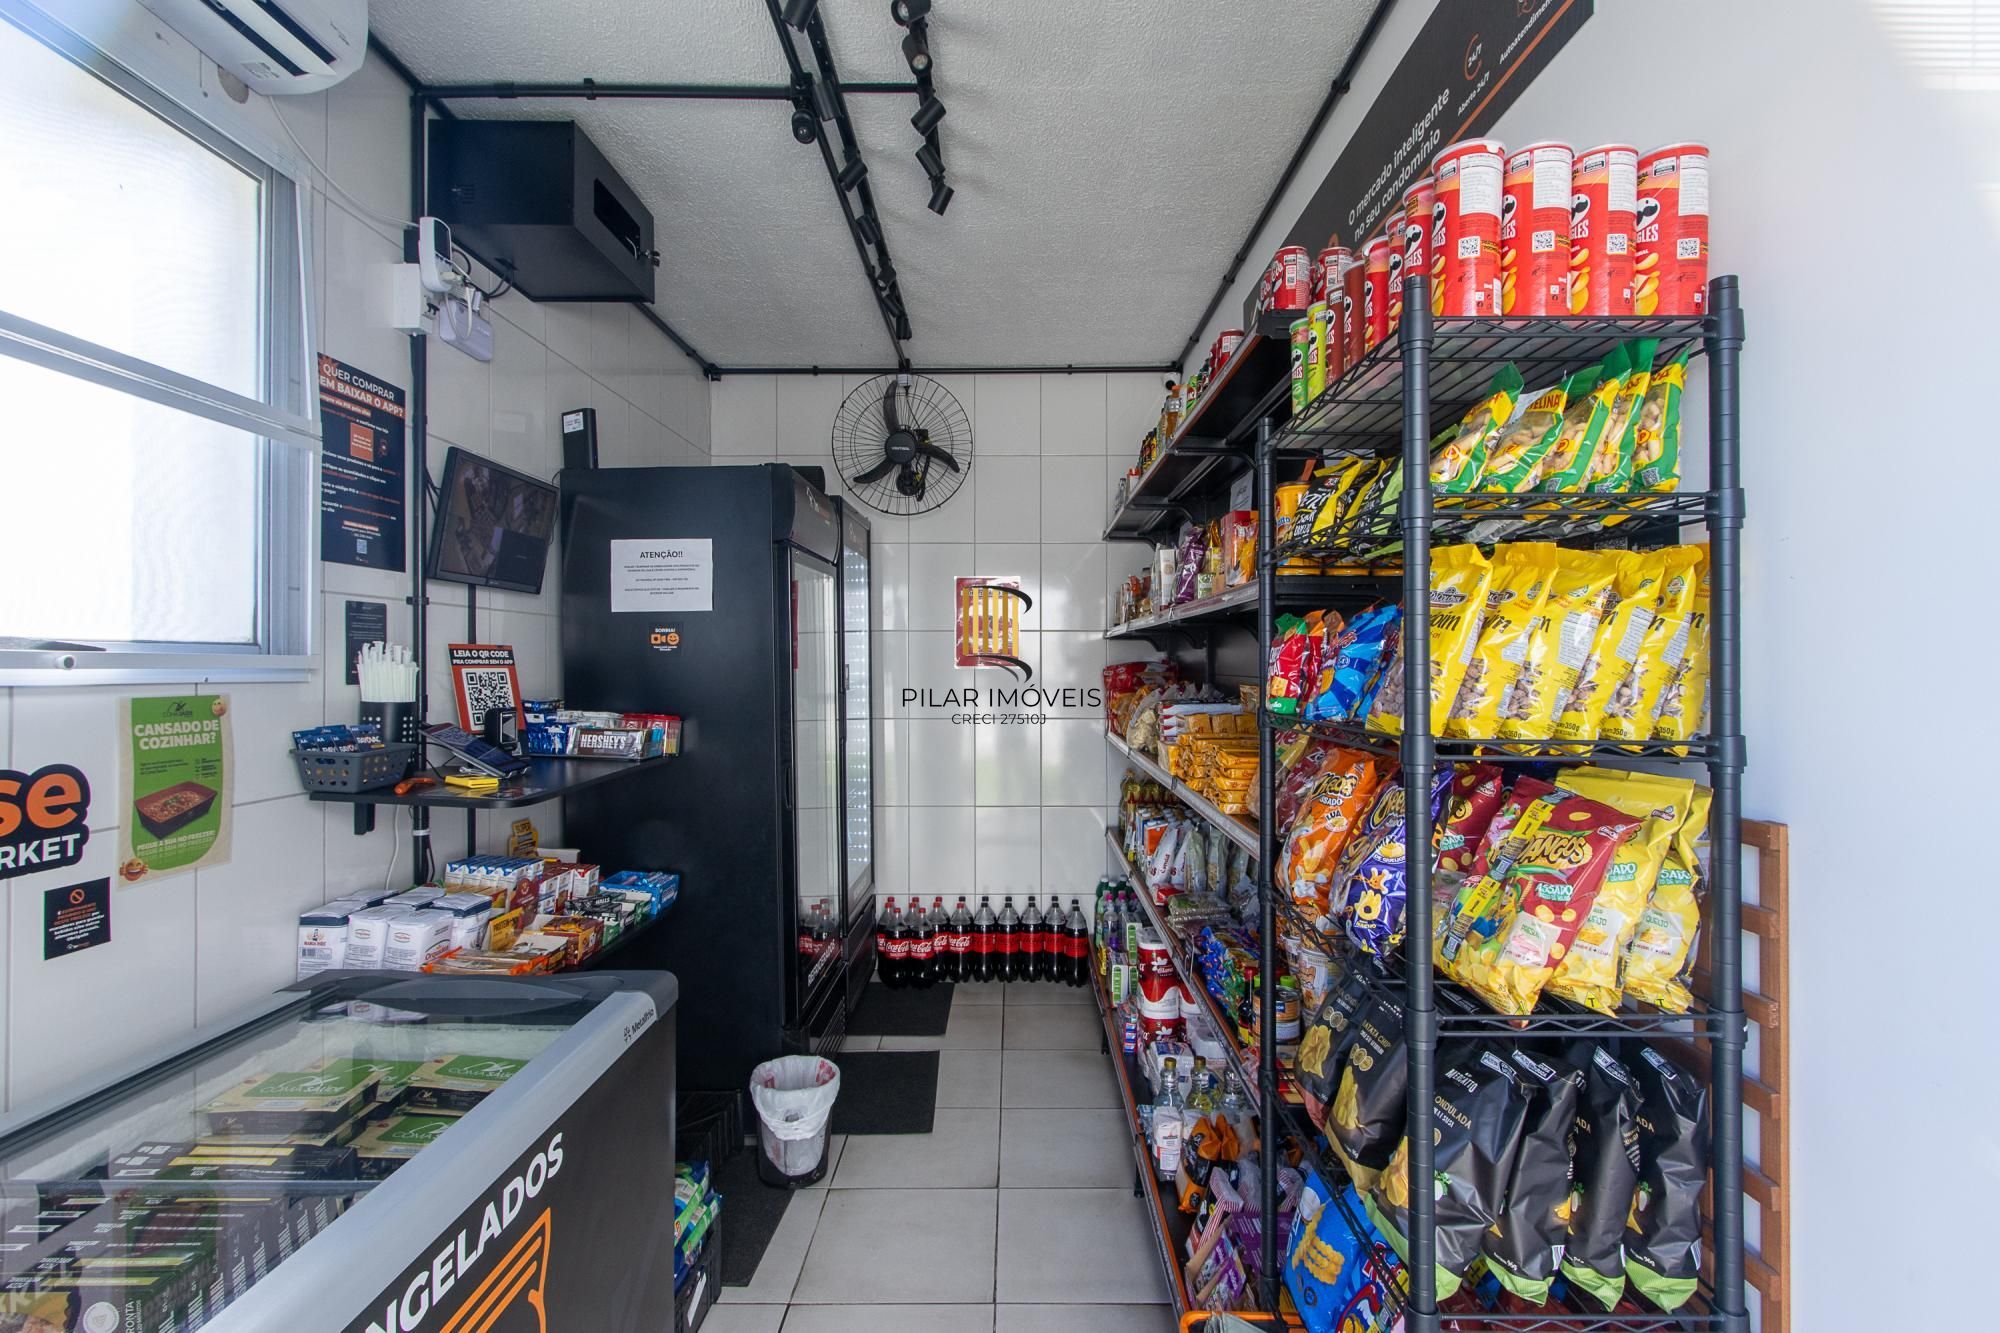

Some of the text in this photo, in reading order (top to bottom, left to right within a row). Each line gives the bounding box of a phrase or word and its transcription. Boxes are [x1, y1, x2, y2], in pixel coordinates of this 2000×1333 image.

[1348, 87, 1450, 226] O mercado inteligente
[1354, 128, 1441, 242] no seu condomínio
[323, 363, 350, 383] QUER
[352, 375, 395, 401] COMPRAR
[319, 375, 335, 390] EM
[337, 382, 373, 405] BAIXAR
[374, 398, 381, 407] O
[383, 400, 404, 417] APP?
[640, 549, 684, 560] ATENÇÃO!!
[479, 650, 490, 658] QR
[134, 719, 219, 737] CANSADO DE
[139, 731, 217, 750] COZINHAR?
[580, 734, 627, 749] HERSHEY'S
[515, 821, 531, 833] SUPER
[1536, 883, 1574, 895] ASSADO
[1434, 1095, 1472, 1131] ONDULADA
